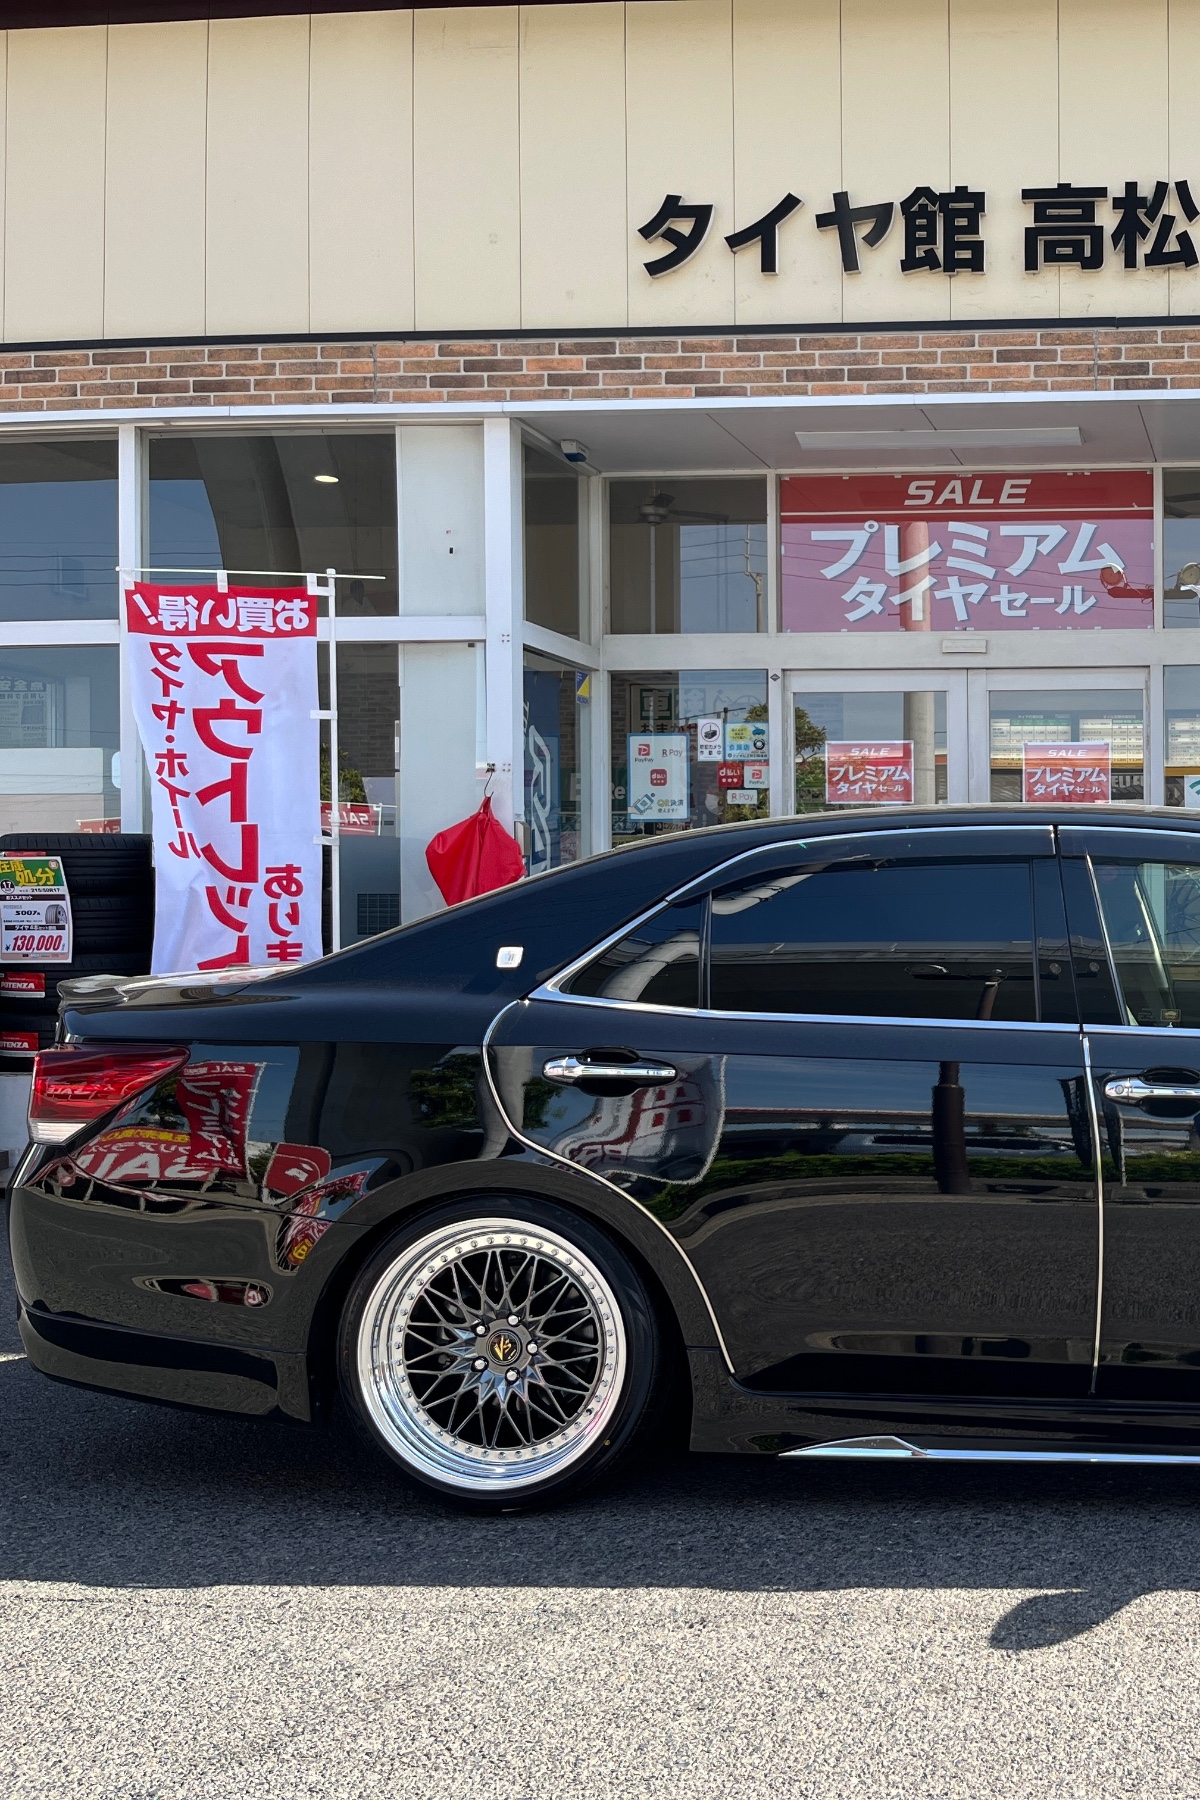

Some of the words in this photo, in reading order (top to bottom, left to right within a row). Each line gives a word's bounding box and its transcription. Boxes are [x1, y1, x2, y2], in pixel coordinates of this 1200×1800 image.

[637, 185, 987, 279] タイヤ館
[904, 478, 1032, 506] SALE
[810, 520, 1127, 580] プレミアム
[841, 575, 1097, 623] タイヤセール
[850, 747, 891, 756] SALE
[1047, 749, 1088, 757] SALE
[720, 768, 741, 777] d払い
[829, 765, 910, 783] プレミアム
[1026, 766, 1108, 784] プレミアム
[836, 782, 905, 795] タイヤセール
[1033, 782, 1102, 796] タイヤセール
[0, 859, 25, 873] 在庫
[2, 881, 12, 889] 17
[15, 868, 56, 887] 処分
